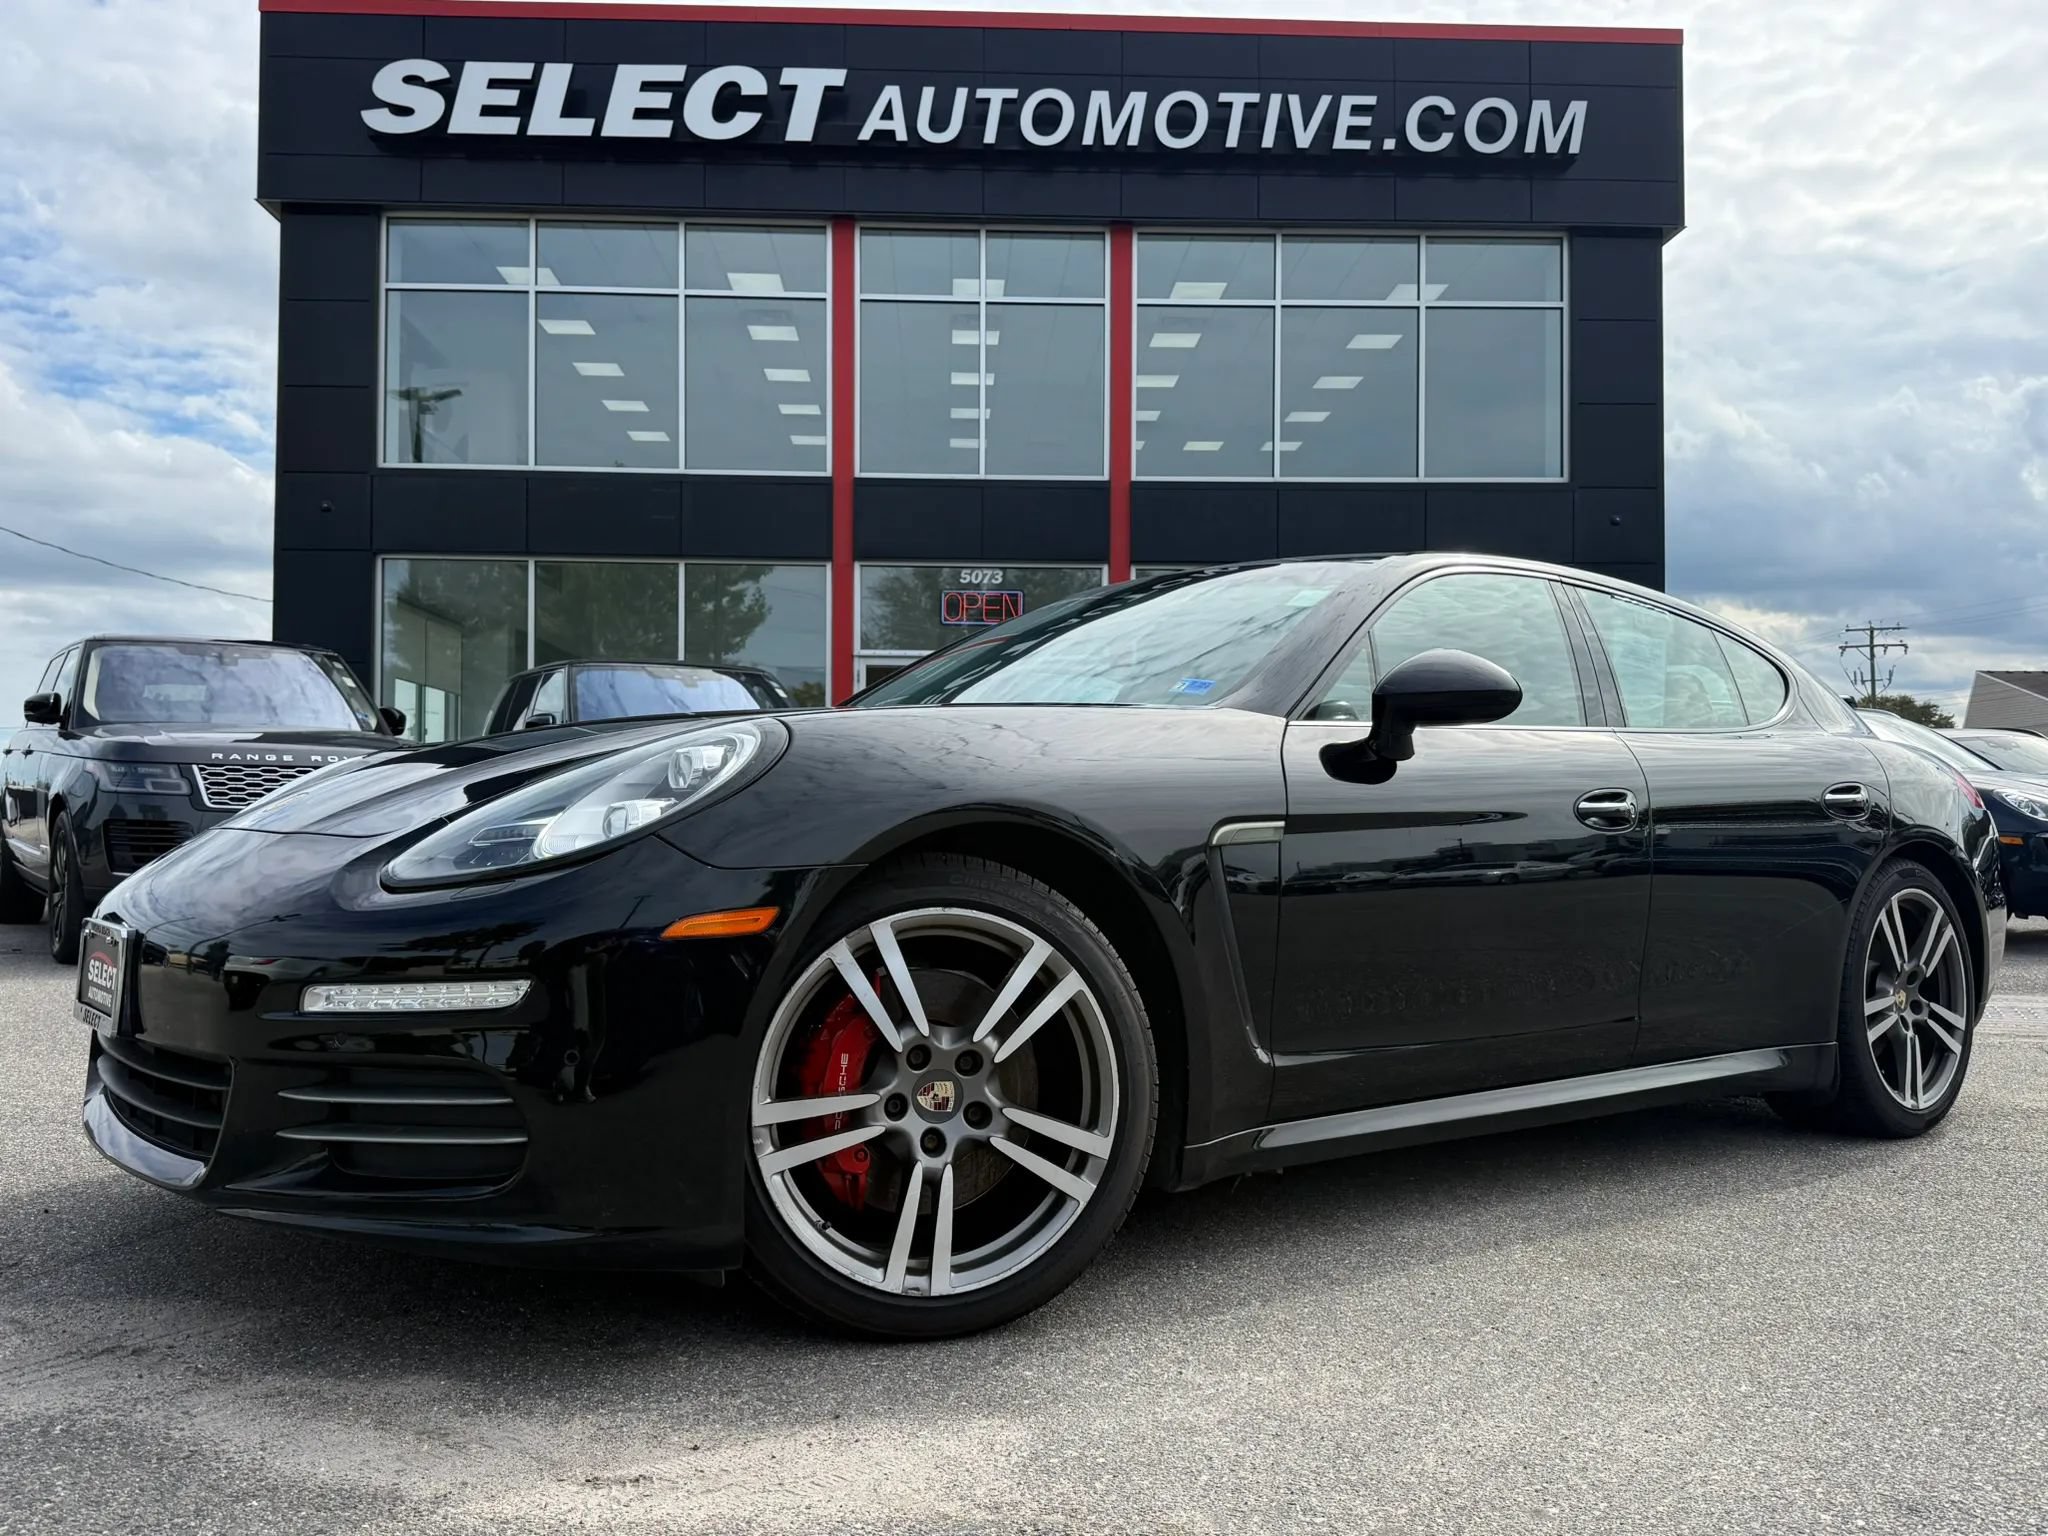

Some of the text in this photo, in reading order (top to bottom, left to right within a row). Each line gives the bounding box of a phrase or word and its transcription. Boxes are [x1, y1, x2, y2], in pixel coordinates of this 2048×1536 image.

[360, 58, 1588, 155] SELECT AUTOMOTIVE.COM
[960, 569, 1004, 584] 5073
[944, 592, 1021, 622] OPEN
[211, 752, 294, 762] RANGE
[88, 959, 117, 990] SELECT
[88, 985, 112, 1007] AUTOMOTIVE
[83, 1008, 101, 1029] SELECT
